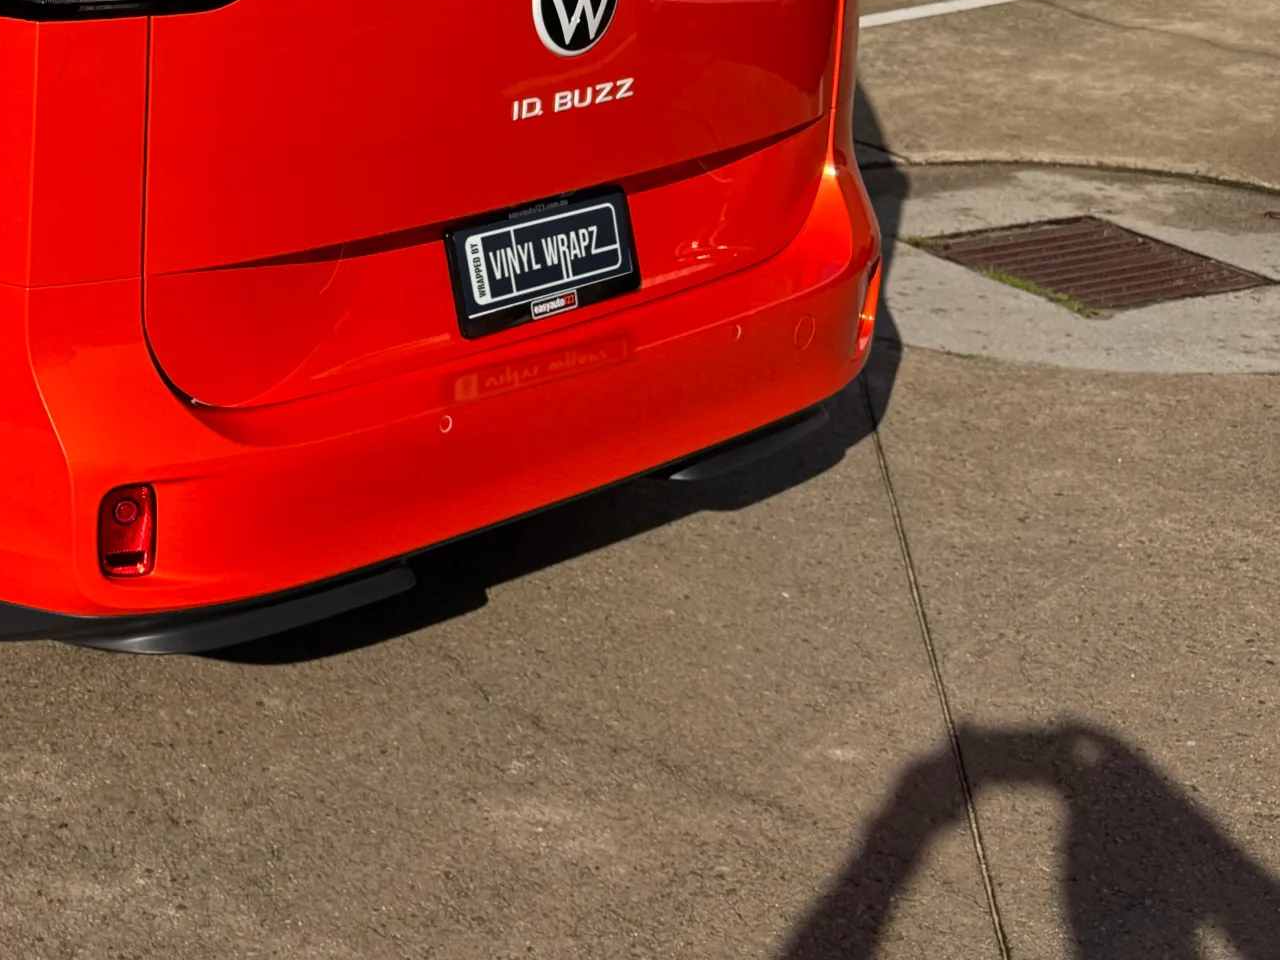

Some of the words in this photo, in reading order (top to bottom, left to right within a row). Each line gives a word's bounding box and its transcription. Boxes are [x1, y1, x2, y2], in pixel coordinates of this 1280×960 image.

[554, 78, 634, 112] BUZZ
[470, 243, 480, 256] BY
[489, 241, 541, 281] VINYL
[541, 225, 603, 270] WRAPZ
[472, 256, 487, 298] WRAPPED
